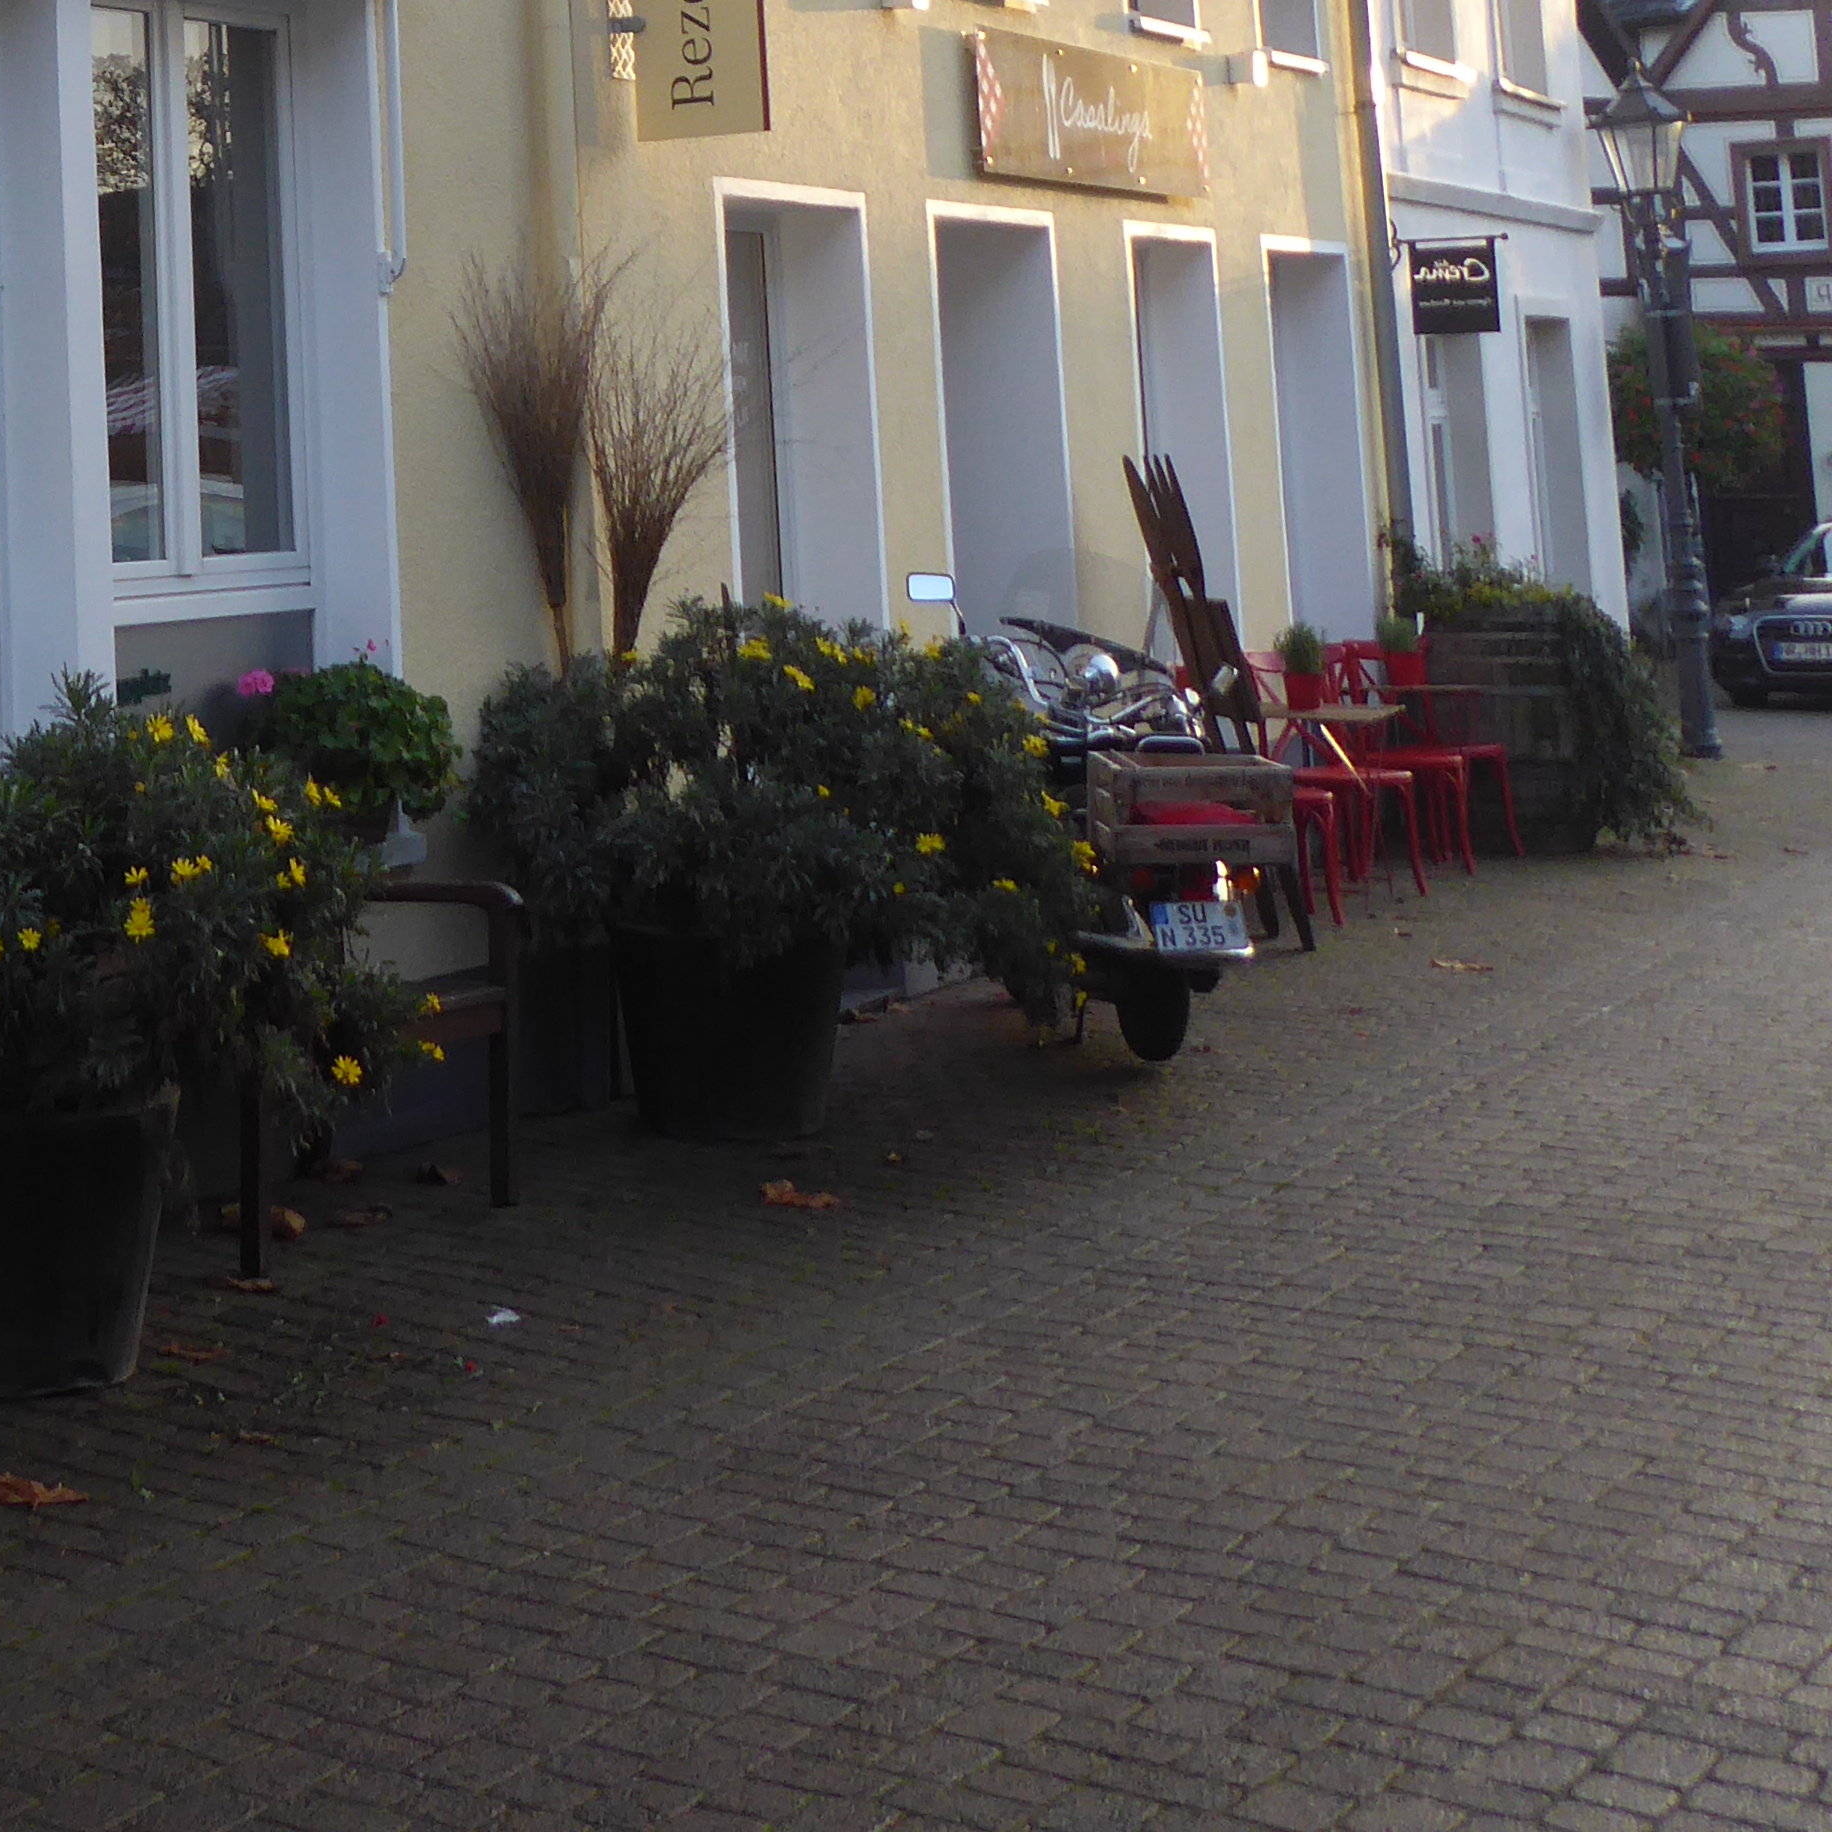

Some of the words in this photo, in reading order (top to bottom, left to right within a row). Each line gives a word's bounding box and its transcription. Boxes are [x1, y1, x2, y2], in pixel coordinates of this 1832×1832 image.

[1178, 904, 1207, 925] SU
[1161, 928, 1177, 947] N
[1182, 925, 1226, 946] 335
